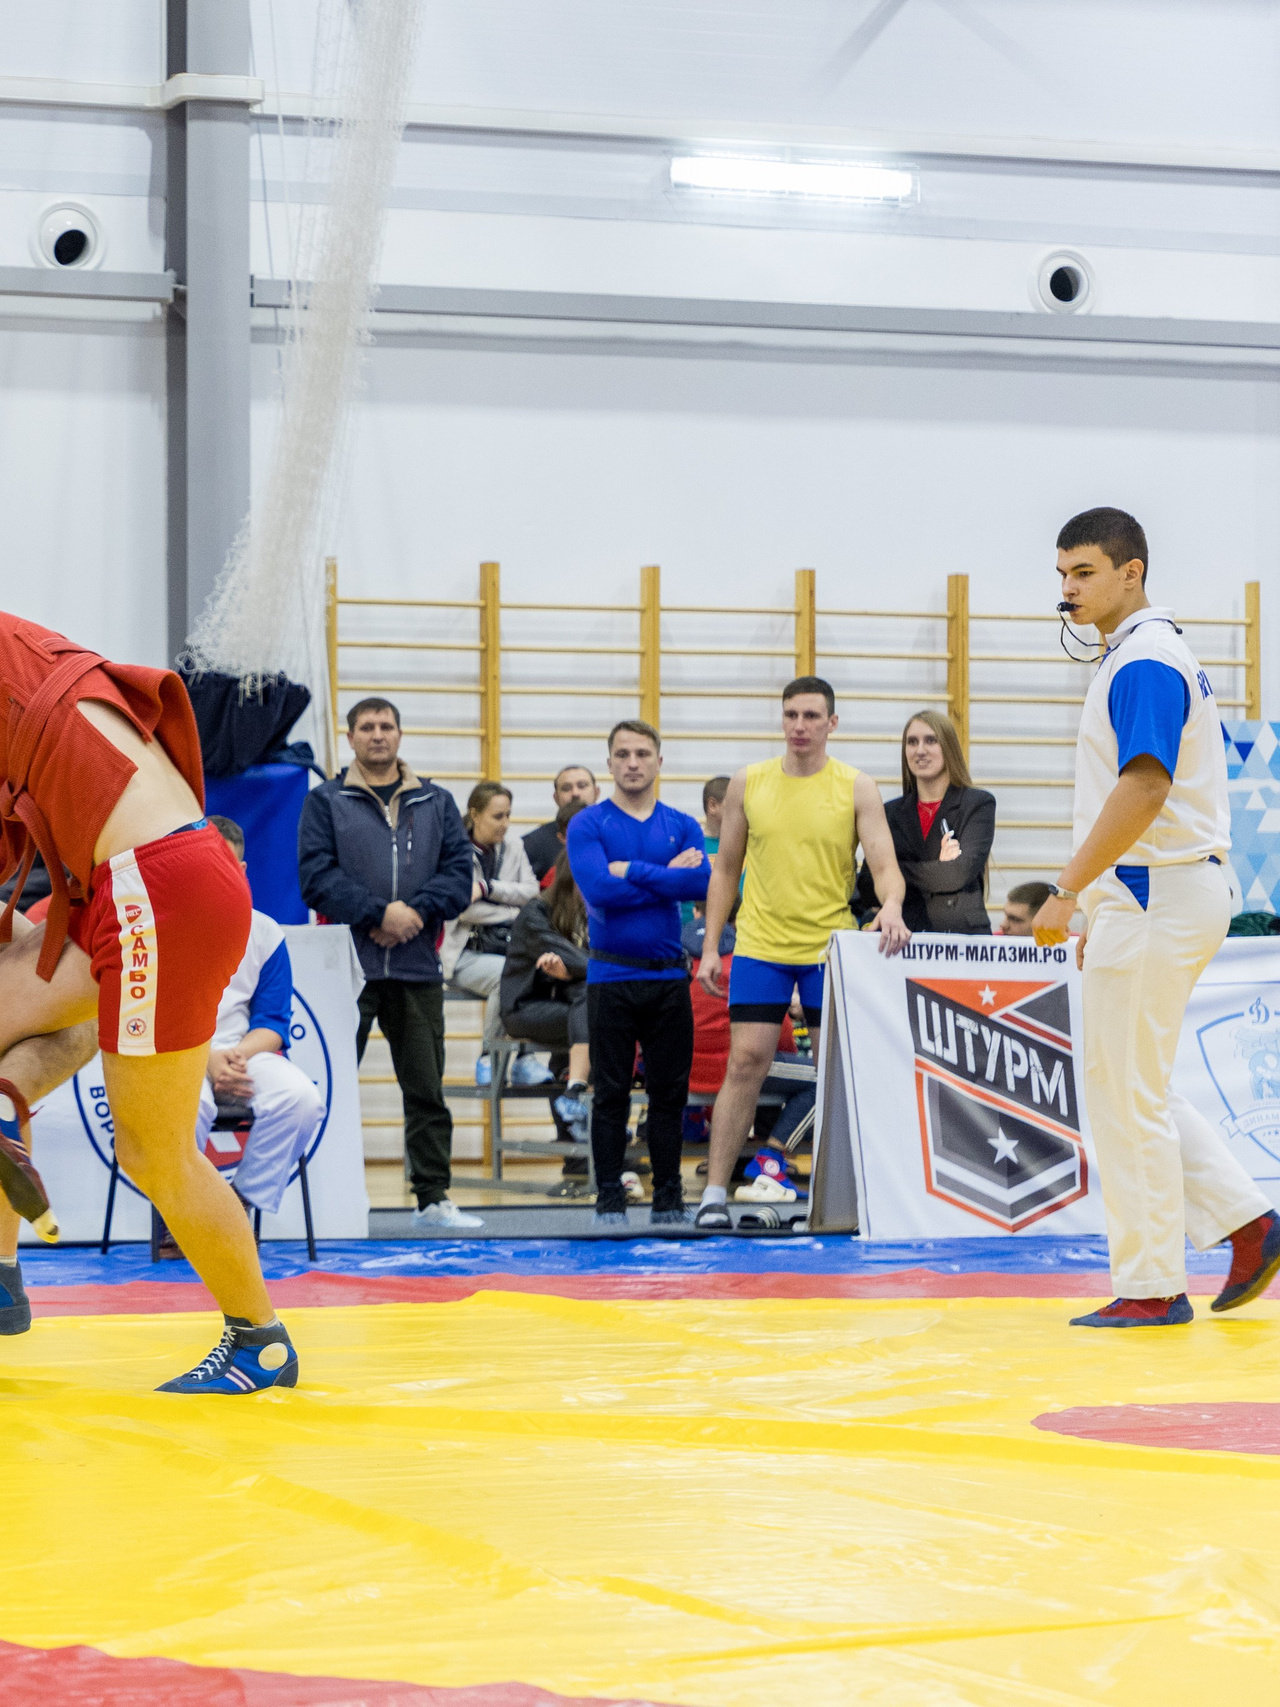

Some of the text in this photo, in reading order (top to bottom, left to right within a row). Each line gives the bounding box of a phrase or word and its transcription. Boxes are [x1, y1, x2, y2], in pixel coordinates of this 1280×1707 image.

[129, 925, 149, 999] САМБО
[901, 943, 1067, 964] ШТУРМ-МАГАЗИН.РФ
[916, 993, 1069, 1118] ШТУРМ
